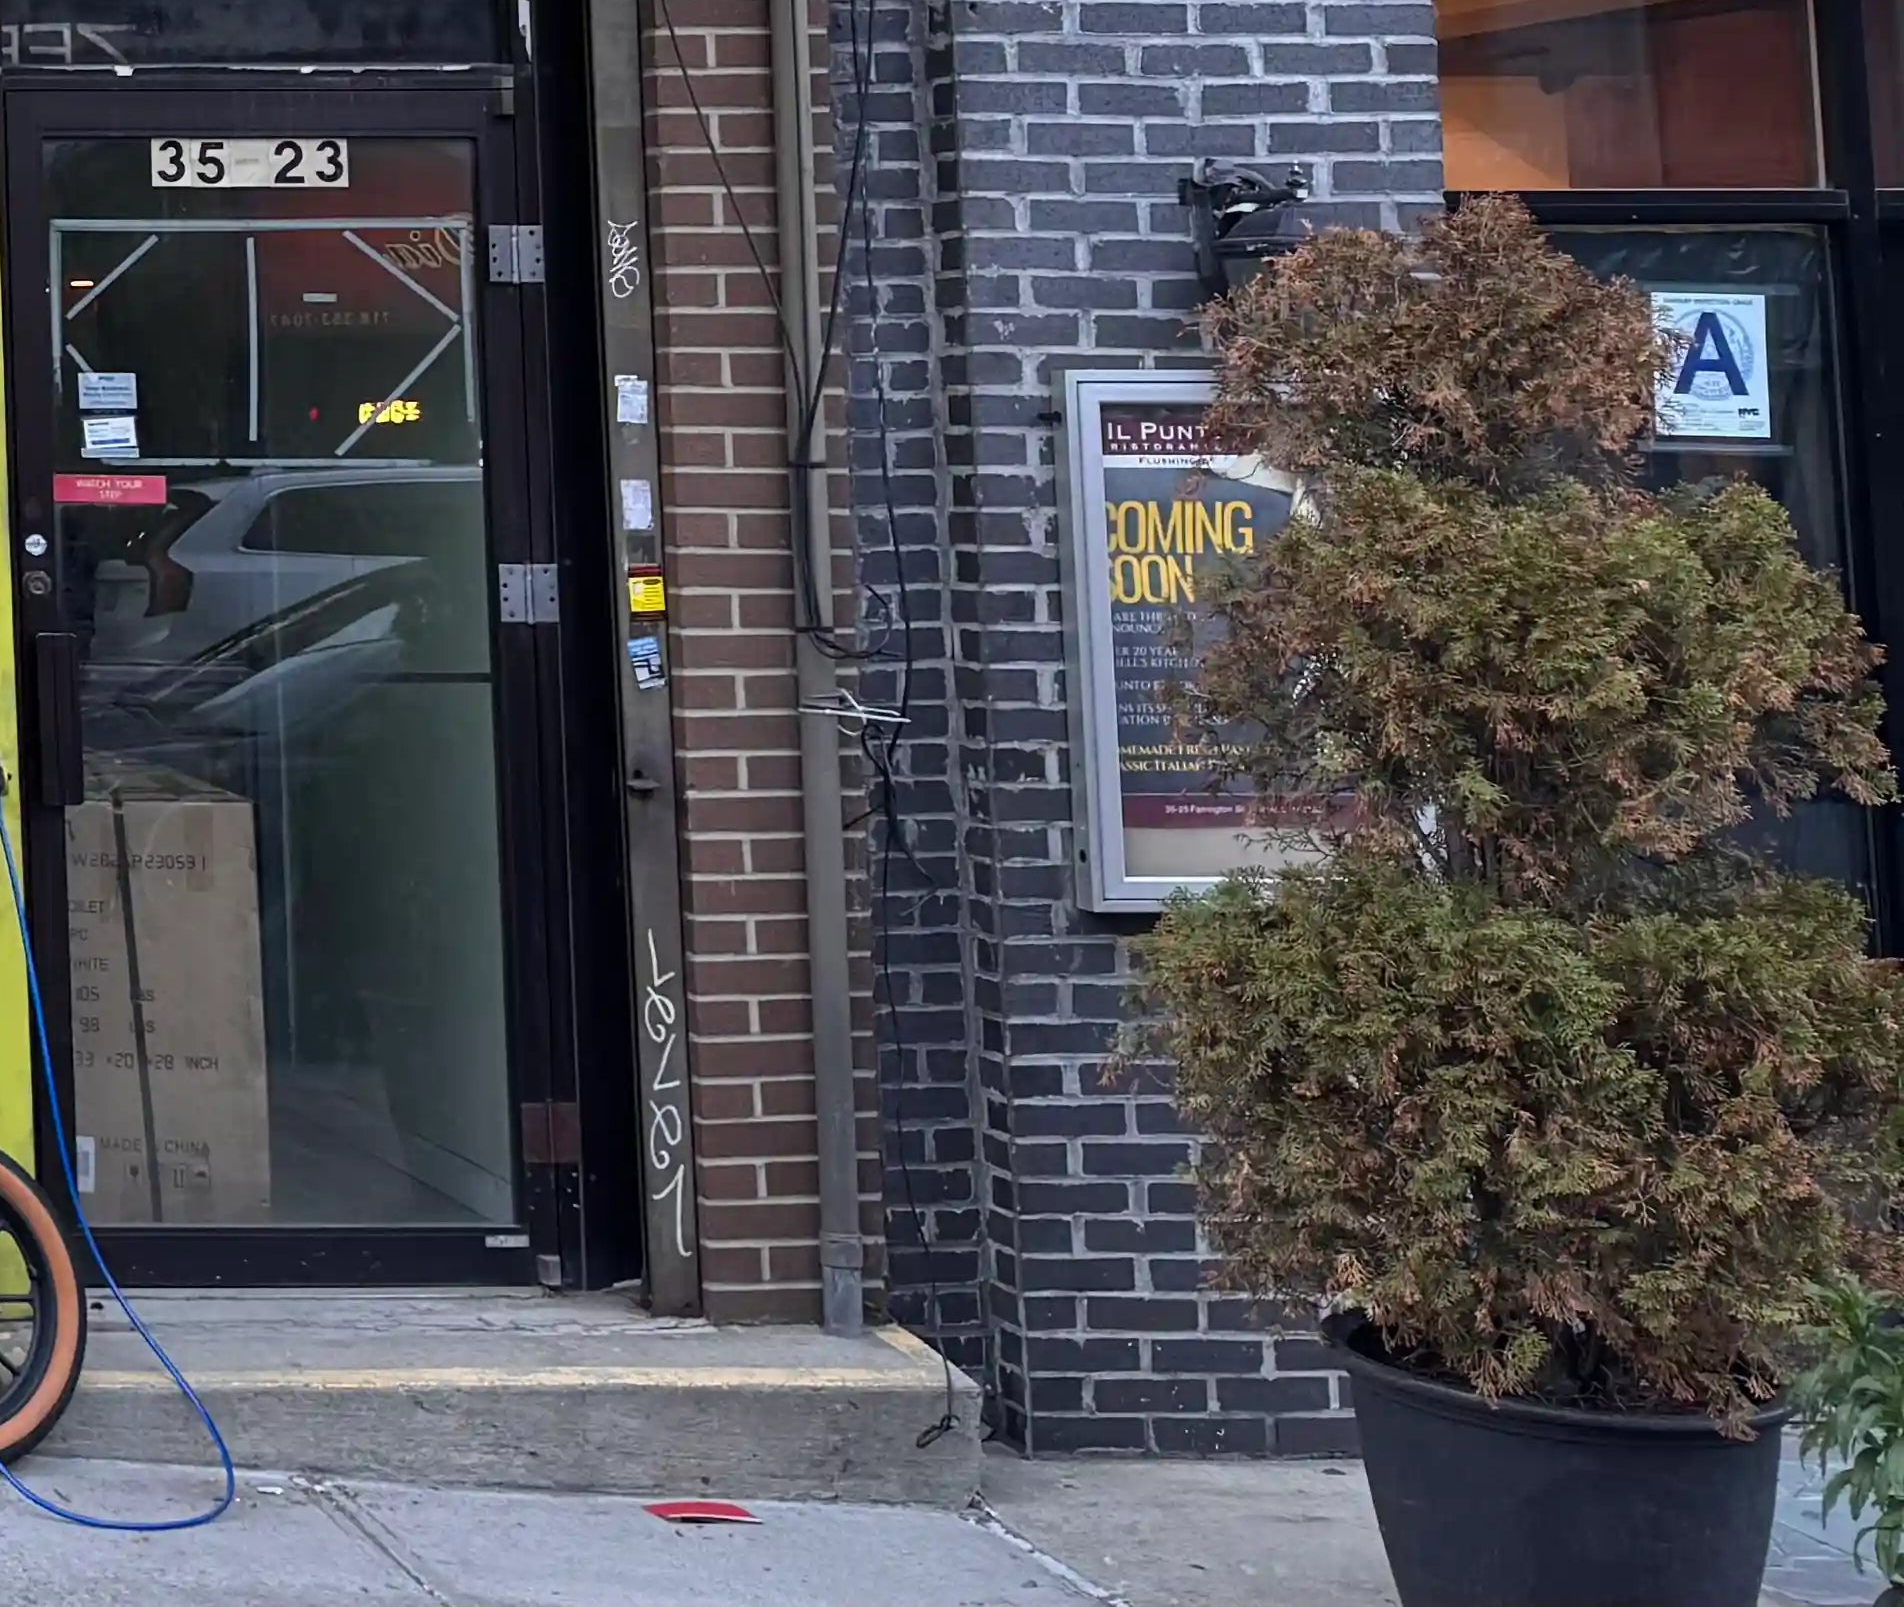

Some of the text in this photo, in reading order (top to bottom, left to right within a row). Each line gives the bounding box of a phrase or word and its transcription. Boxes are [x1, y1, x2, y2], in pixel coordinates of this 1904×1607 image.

[1674, 312, 1749, 396] A
[1107, 422, 1210, 441] IL PUNT
[1110, 554, 1195, 605] OON
